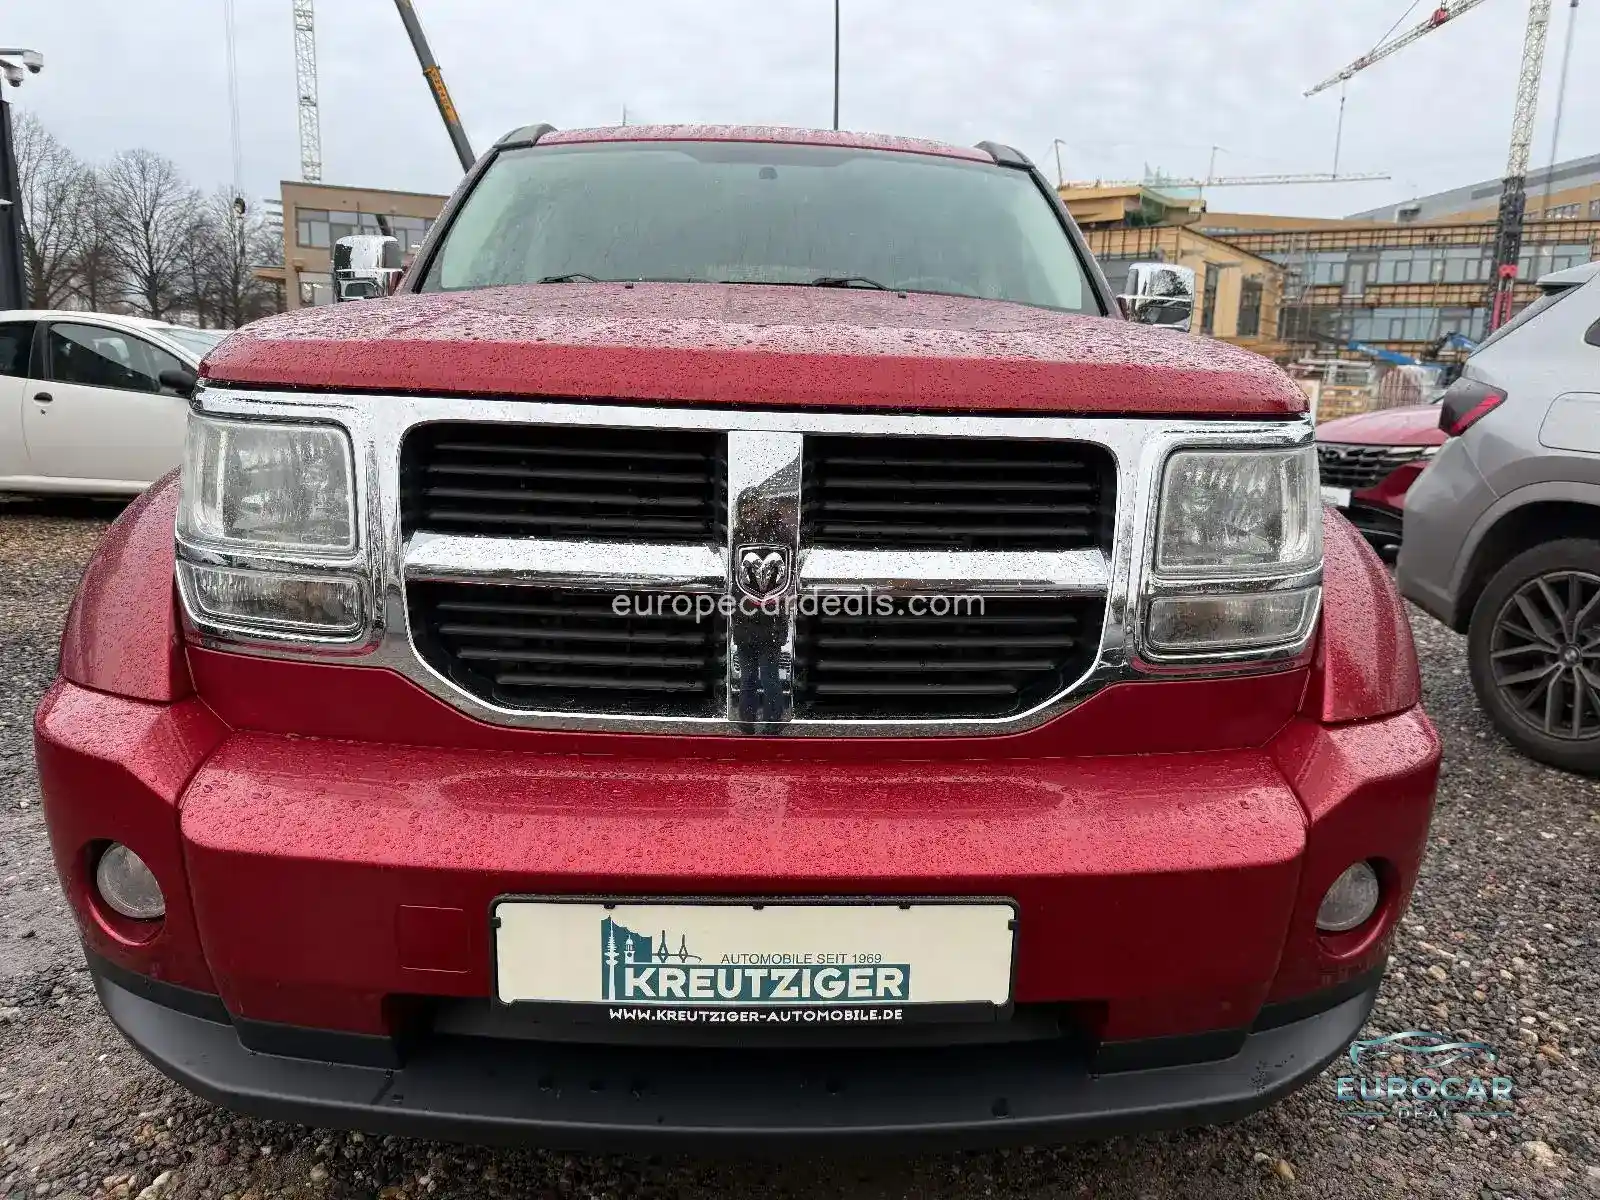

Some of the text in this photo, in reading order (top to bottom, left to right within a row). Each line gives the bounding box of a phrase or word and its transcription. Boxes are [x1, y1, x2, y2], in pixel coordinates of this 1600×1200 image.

[720, 952, 882, 964] AUTOMOBILE SEIT 1969
[626, 968, 904, 999] KREUTZIGER
[609, 1008, 903, 1021] WWW.KREUTZIGER-AUTOMOBILE.DE
